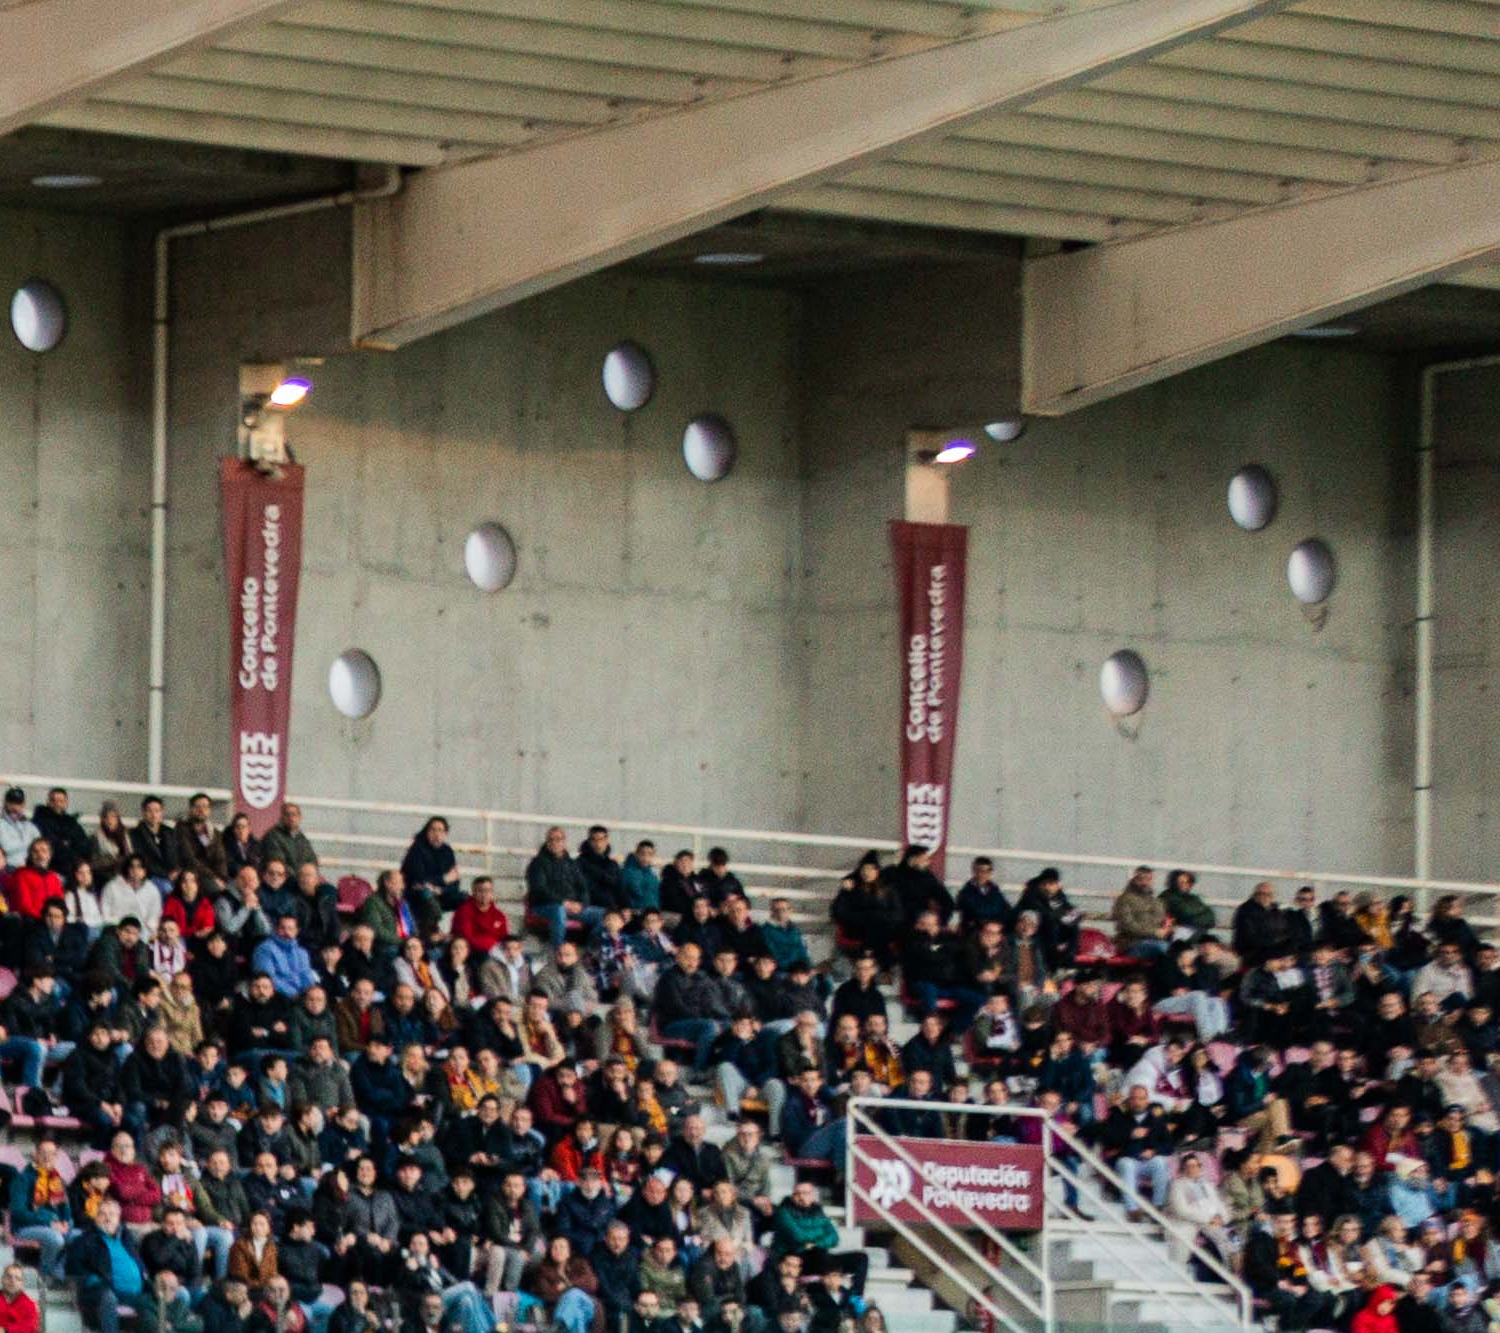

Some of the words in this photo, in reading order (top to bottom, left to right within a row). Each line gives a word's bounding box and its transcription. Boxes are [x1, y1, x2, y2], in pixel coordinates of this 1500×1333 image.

[261, 504, 281, 652] Pontevedra
[239, 576, 259, 689] Concello
[261, 653, 279, 691] de
[928, 565, 947, 706] Pontevedra
[906, 634, 927, 742] Concello
[927, 707, 945, 744] de
[922, 1161, 1030, 1189] Deputación
